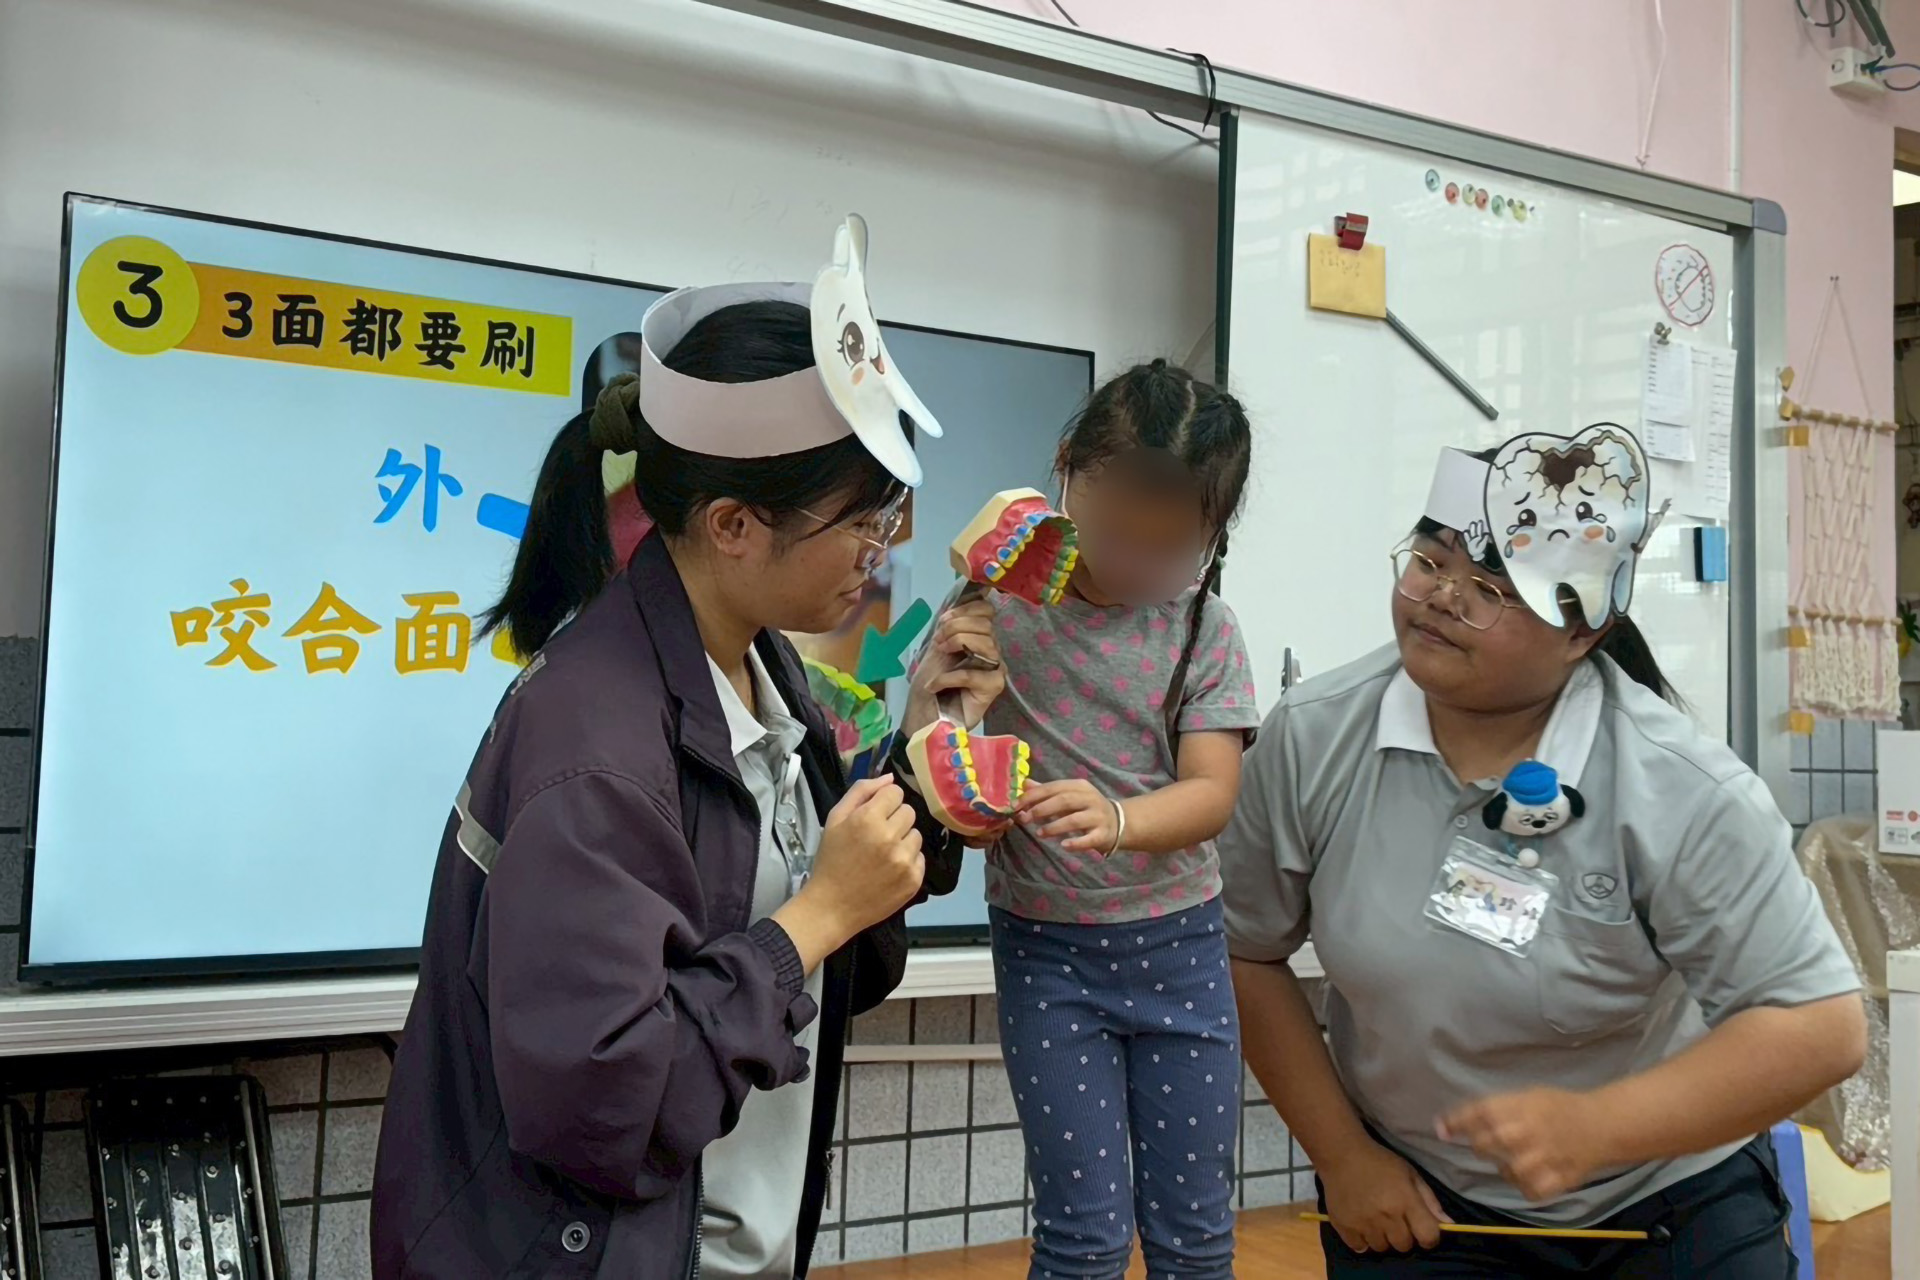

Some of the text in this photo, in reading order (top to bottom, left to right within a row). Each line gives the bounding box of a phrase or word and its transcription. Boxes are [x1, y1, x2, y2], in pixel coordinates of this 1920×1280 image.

[113, 260, 164, 329] 3
[221, 291, 536, 378] 3面都要刷
[373, 443, 464, 533] 外
[170, 578, 471, 675] 咬合面
